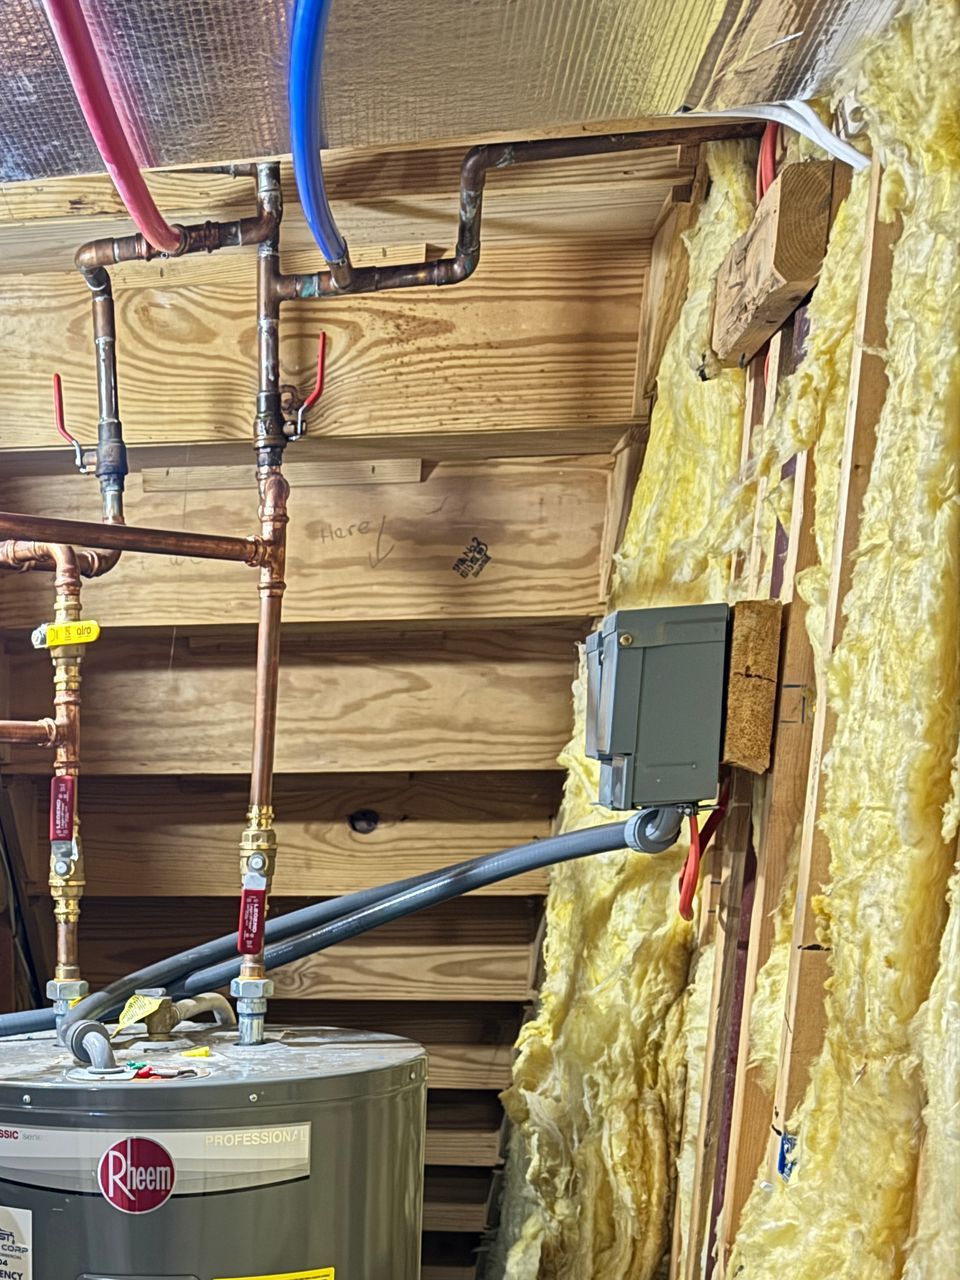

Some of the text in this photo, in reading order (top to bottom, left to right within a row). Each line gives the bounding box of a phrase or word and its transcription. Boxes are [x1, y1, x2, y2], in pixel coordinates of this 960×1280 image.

[320, 519, 370, 543] Here
[251, 903, 259, 934] LEGEND
[205, 1128, 307, 1147] PROFESSIONAL
[108, 1136, 172, 1201] Rheem
[1, 1244, 29, 1254] CORP
